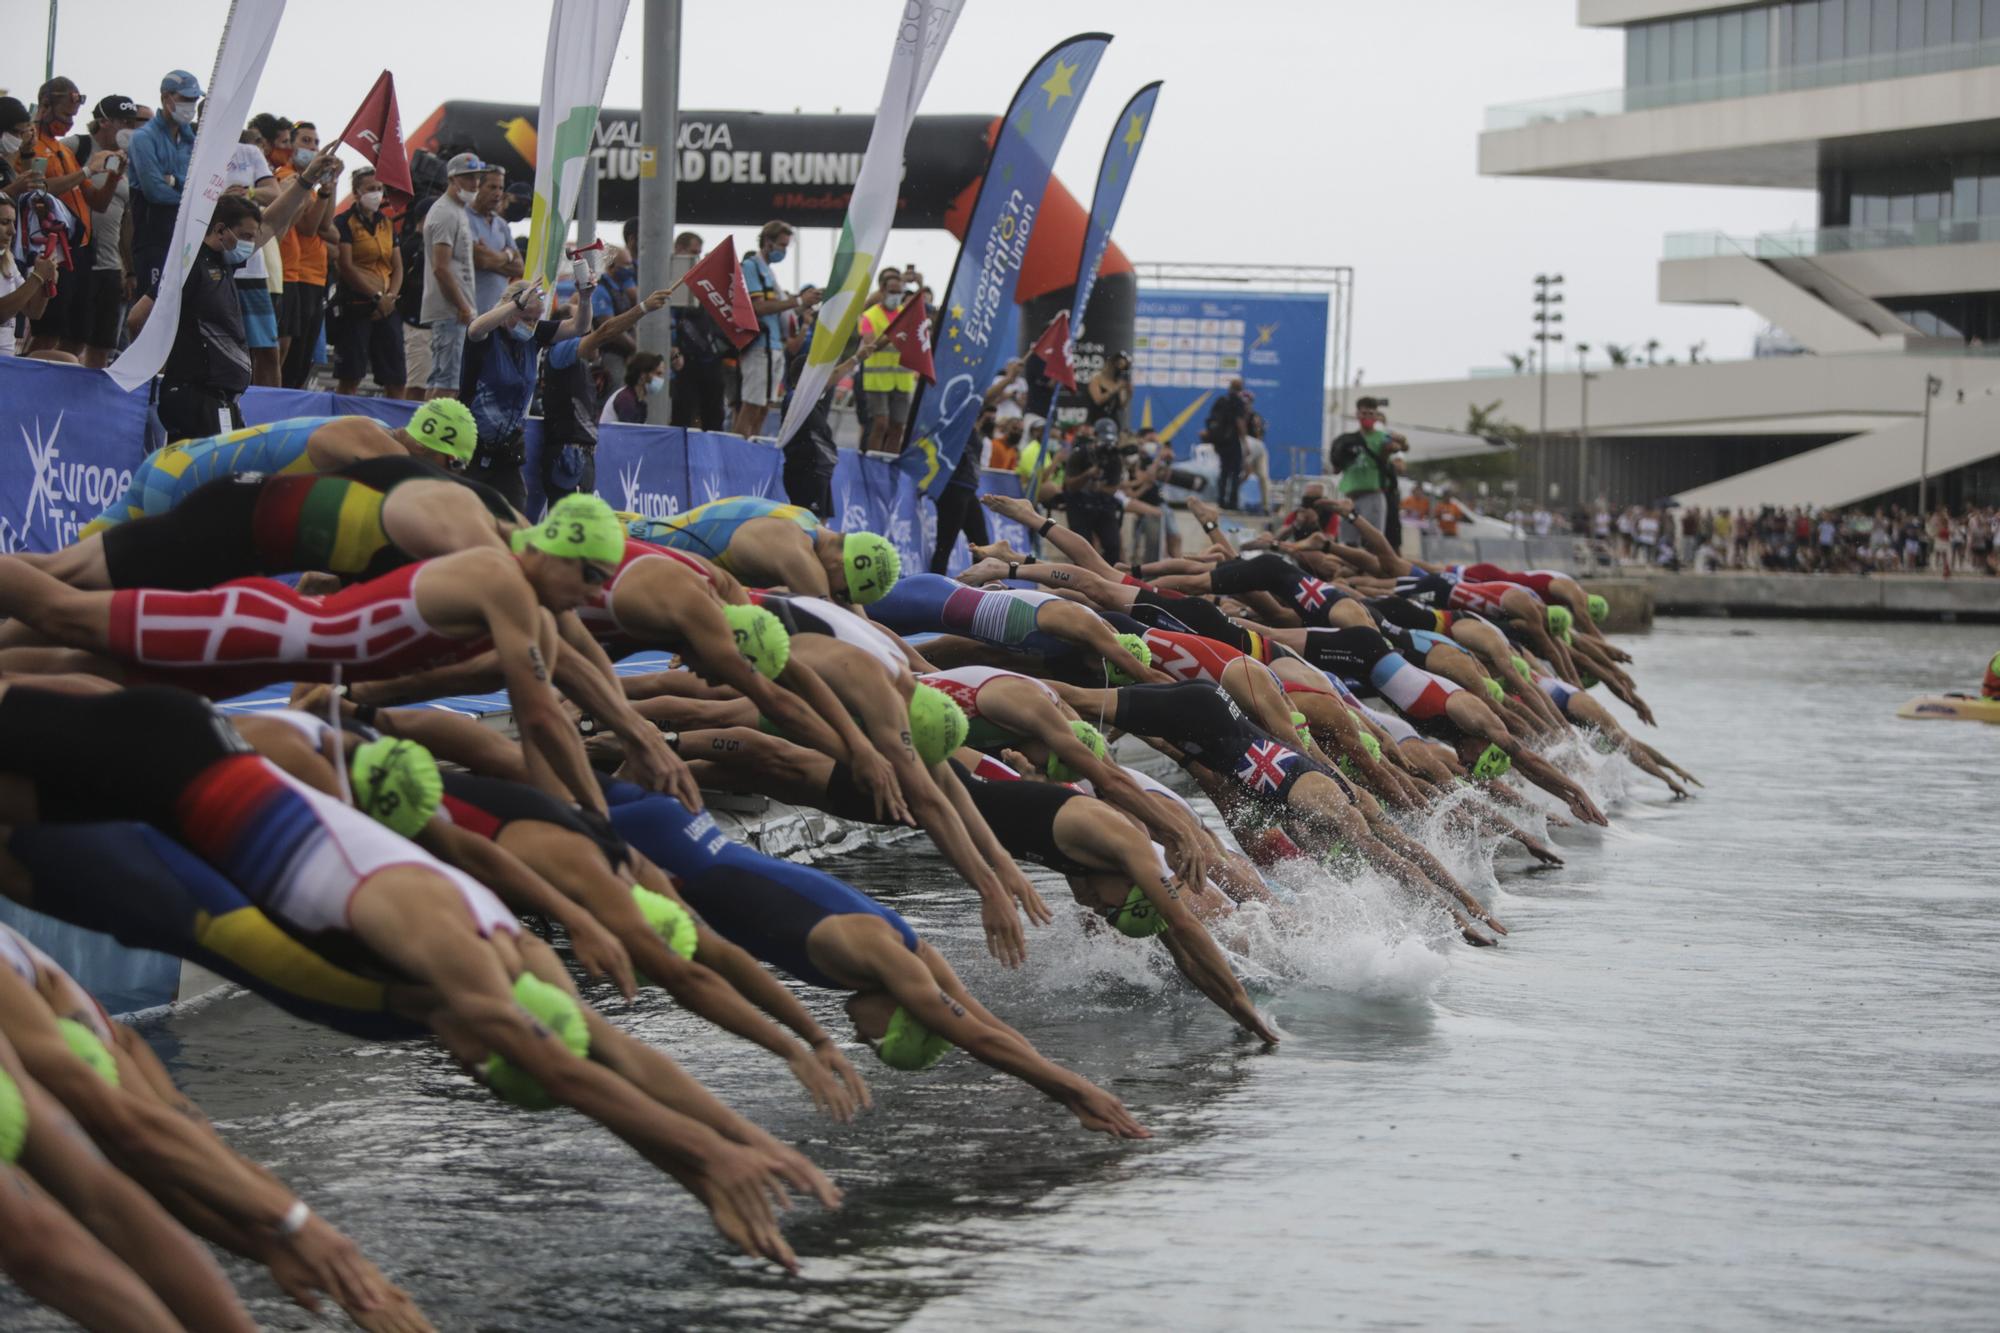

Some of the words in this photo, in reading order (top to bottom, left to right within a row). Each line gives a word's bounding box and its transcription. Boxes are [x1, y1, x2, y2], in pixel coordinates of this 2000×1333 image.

[595, 120, 733, 151] VALCIA
[591, 147, 705, 183] CIUD
[709, 151, 767, 183] DEL
[771, 152, 906, 185] RUNNI
[1007, 202, 1034, 271] Union
[965, 225, 999, 342] European
[975, 188, 1024, 347] Triathlon
[420, 417, 458, 446] 62
[49, 448, 132, 513] Europe
[632, 483, 679, 518] Europe
[545, 520, 586, 544] 63
[853, 554, 876, 592] 61
